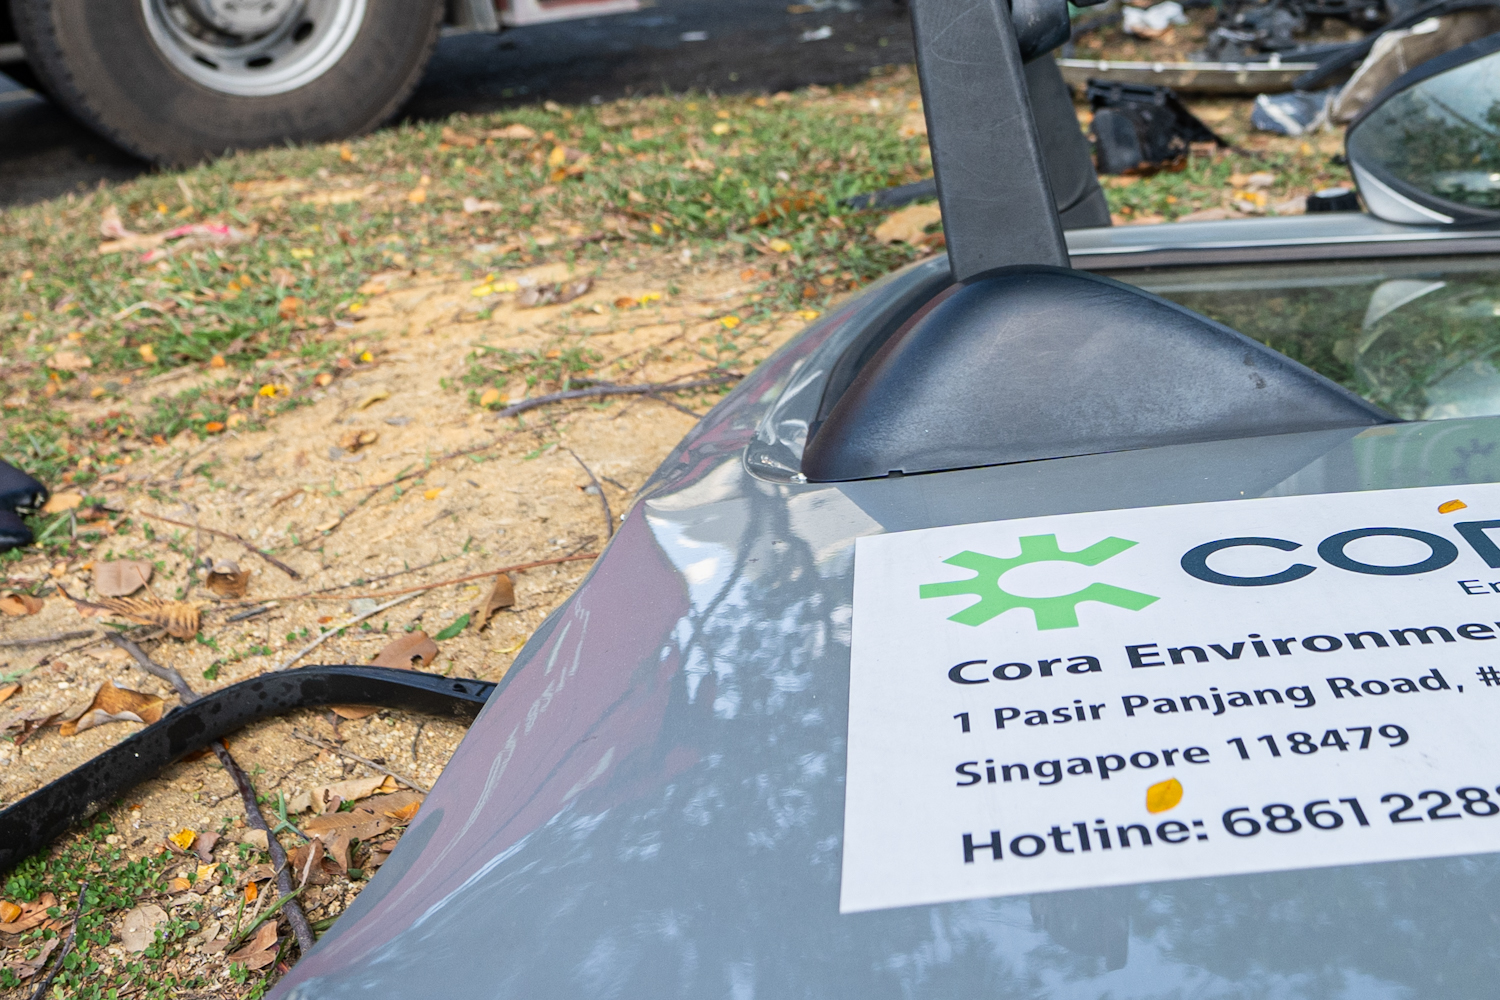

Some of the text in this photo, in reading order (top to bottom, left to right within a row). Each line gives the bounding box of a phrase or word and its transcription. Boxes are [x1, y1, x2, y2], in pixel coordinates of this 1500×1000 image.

[947, 655, 1103, 685] Cora
[953, 712, 971, 733] 1
[994, 699, 1107, 730] Pasir
[1121, 685, 1317, 717] Panjang
[1325, 668, 1464, 699] Road,
[955, 724, 1411, 788] Singapore 118479
[961, 818, 1209, 864] Hotline:
[1221, 797, 1370, 838] 6861
